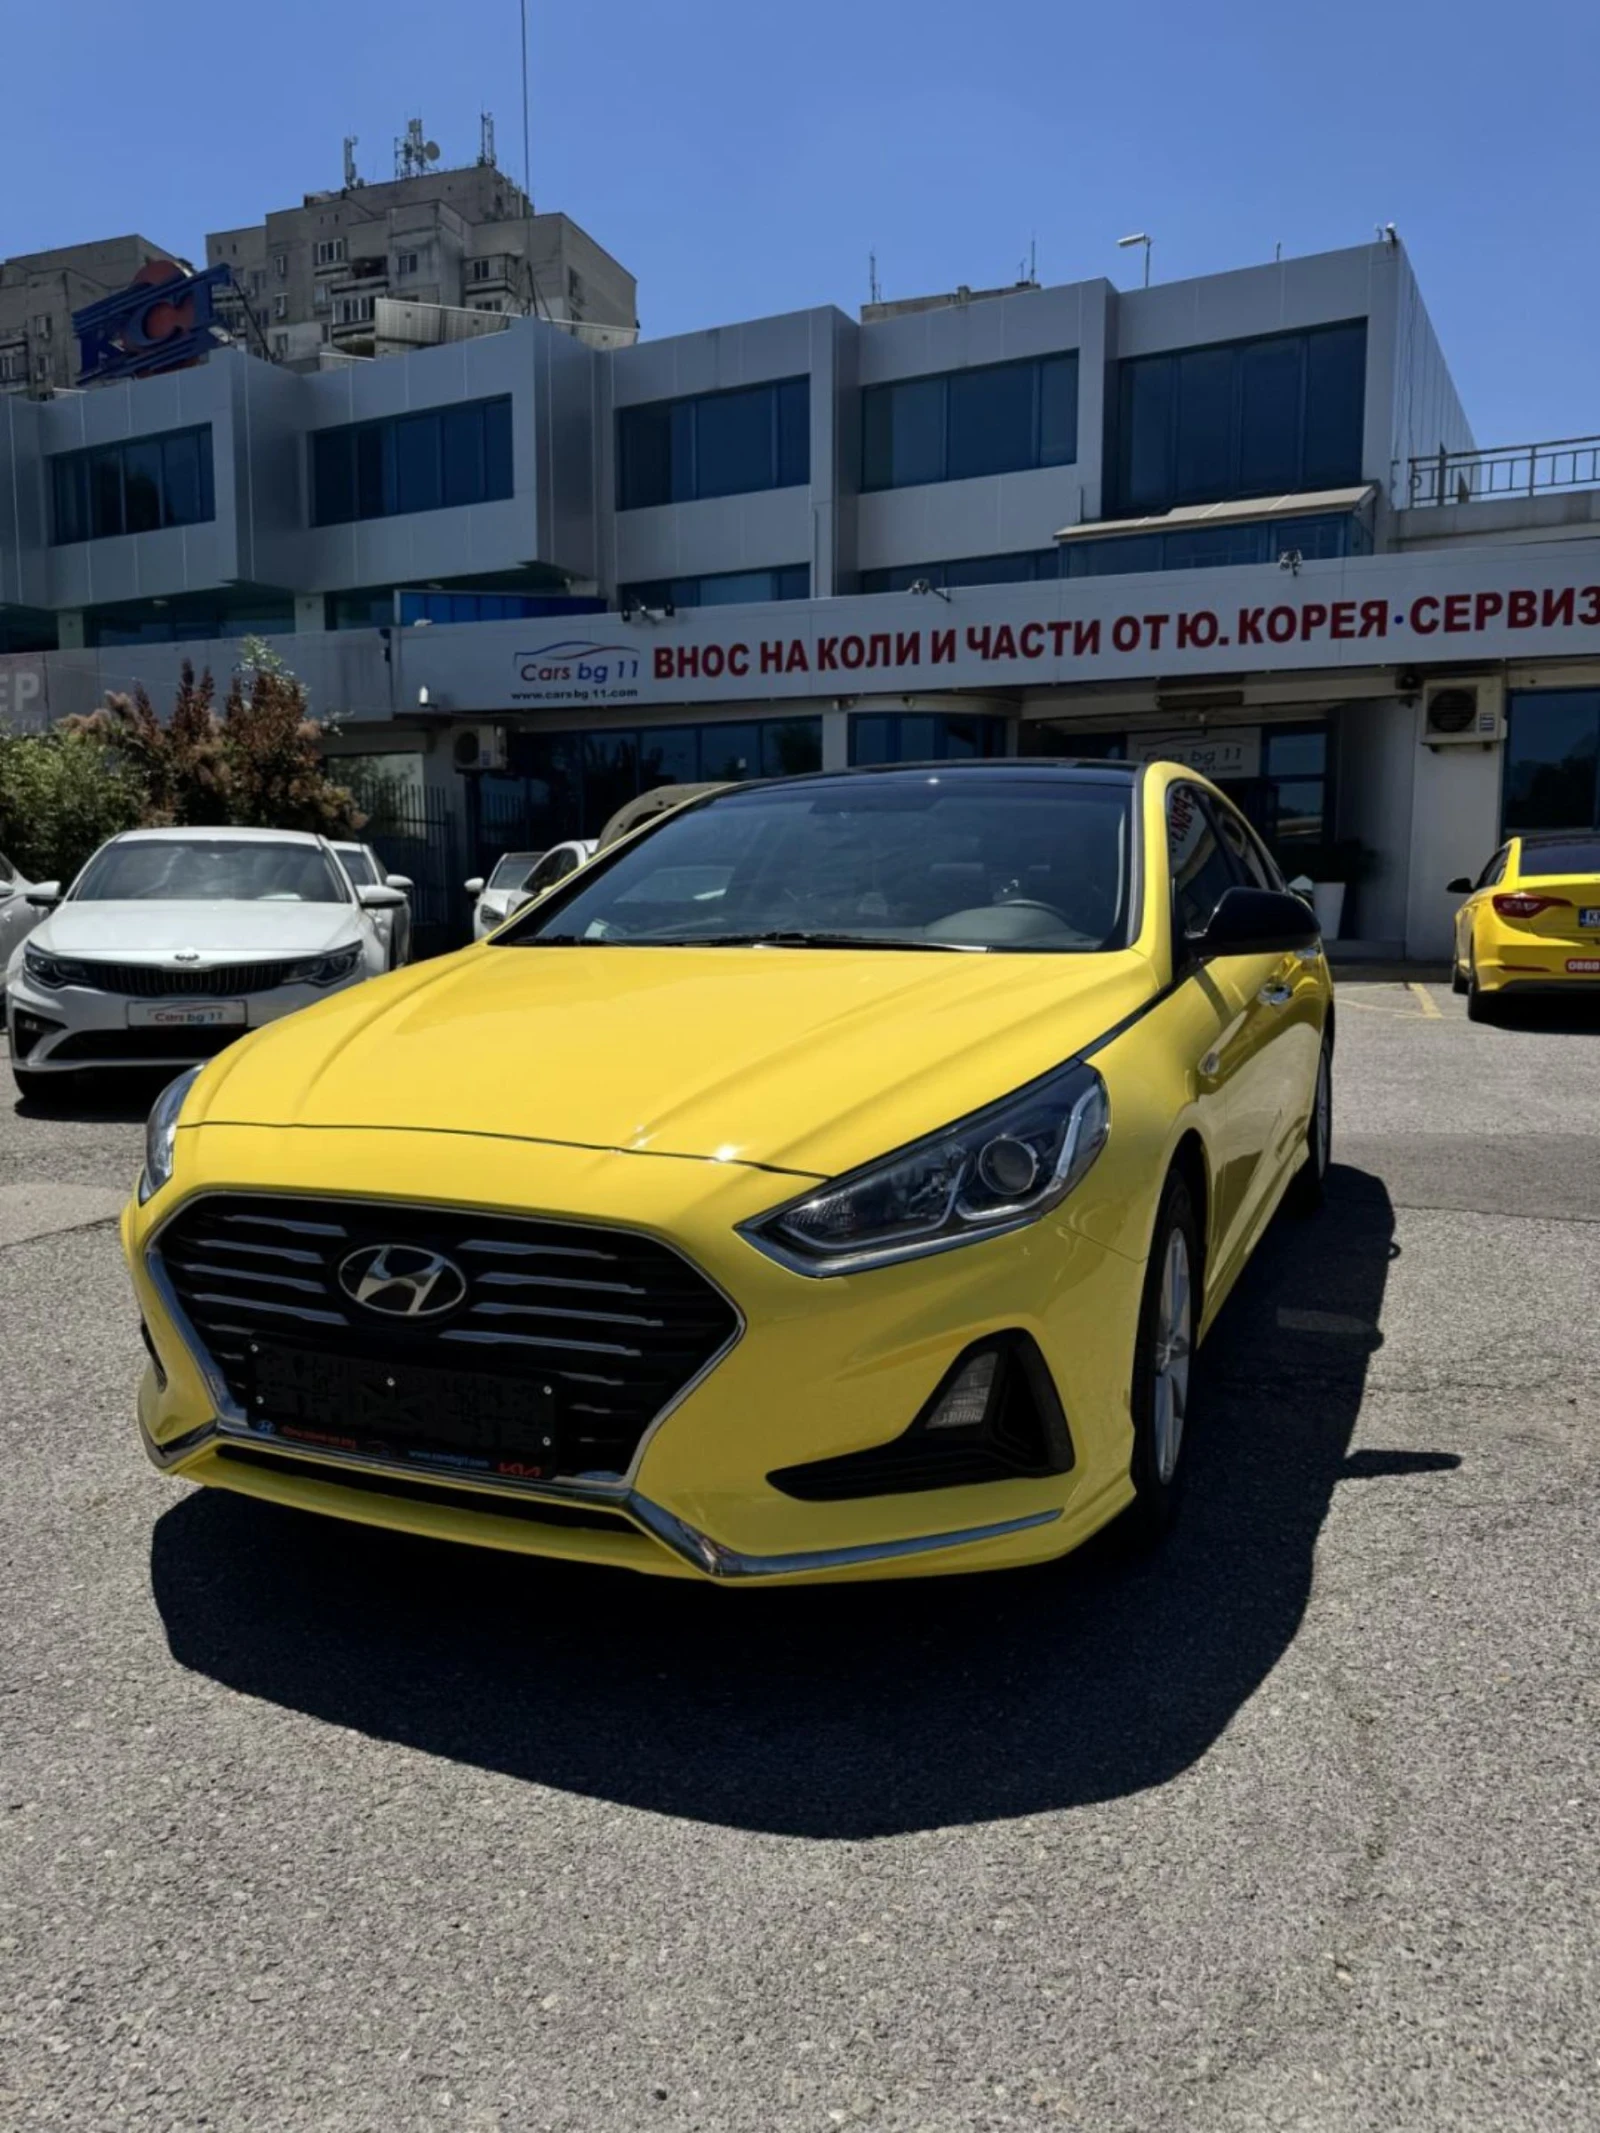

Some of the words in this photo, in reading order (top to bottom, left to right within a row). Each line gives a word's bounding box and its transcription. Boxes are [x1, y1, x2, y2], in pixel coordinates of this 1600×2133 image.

[653, 643, 749, 679] ВНОС
[760, 639, 809, 674] НА
[817, 630, 921, 671] КОЛИ
[931, 629, 956, 664] И
[966, 619, 1101, 660] ЧАСТИ
[1112, 614, 1170, 652] ОТ
[1176, 610, 1230, 649] Ю.
[1238, 600, 1389, 645] КОРЕЯ
[1410, 585, 1600, 635] СЕРВИЗ
[520, 663, 571, 682] Cars
[577, 662, 608, 683] bg
[617, 659, 639, 678] 11
[1190, 750, 1216, 765] bg
[154, 1012, 184, 1022] Cars
[187, 1012, 205, 1023] bg
